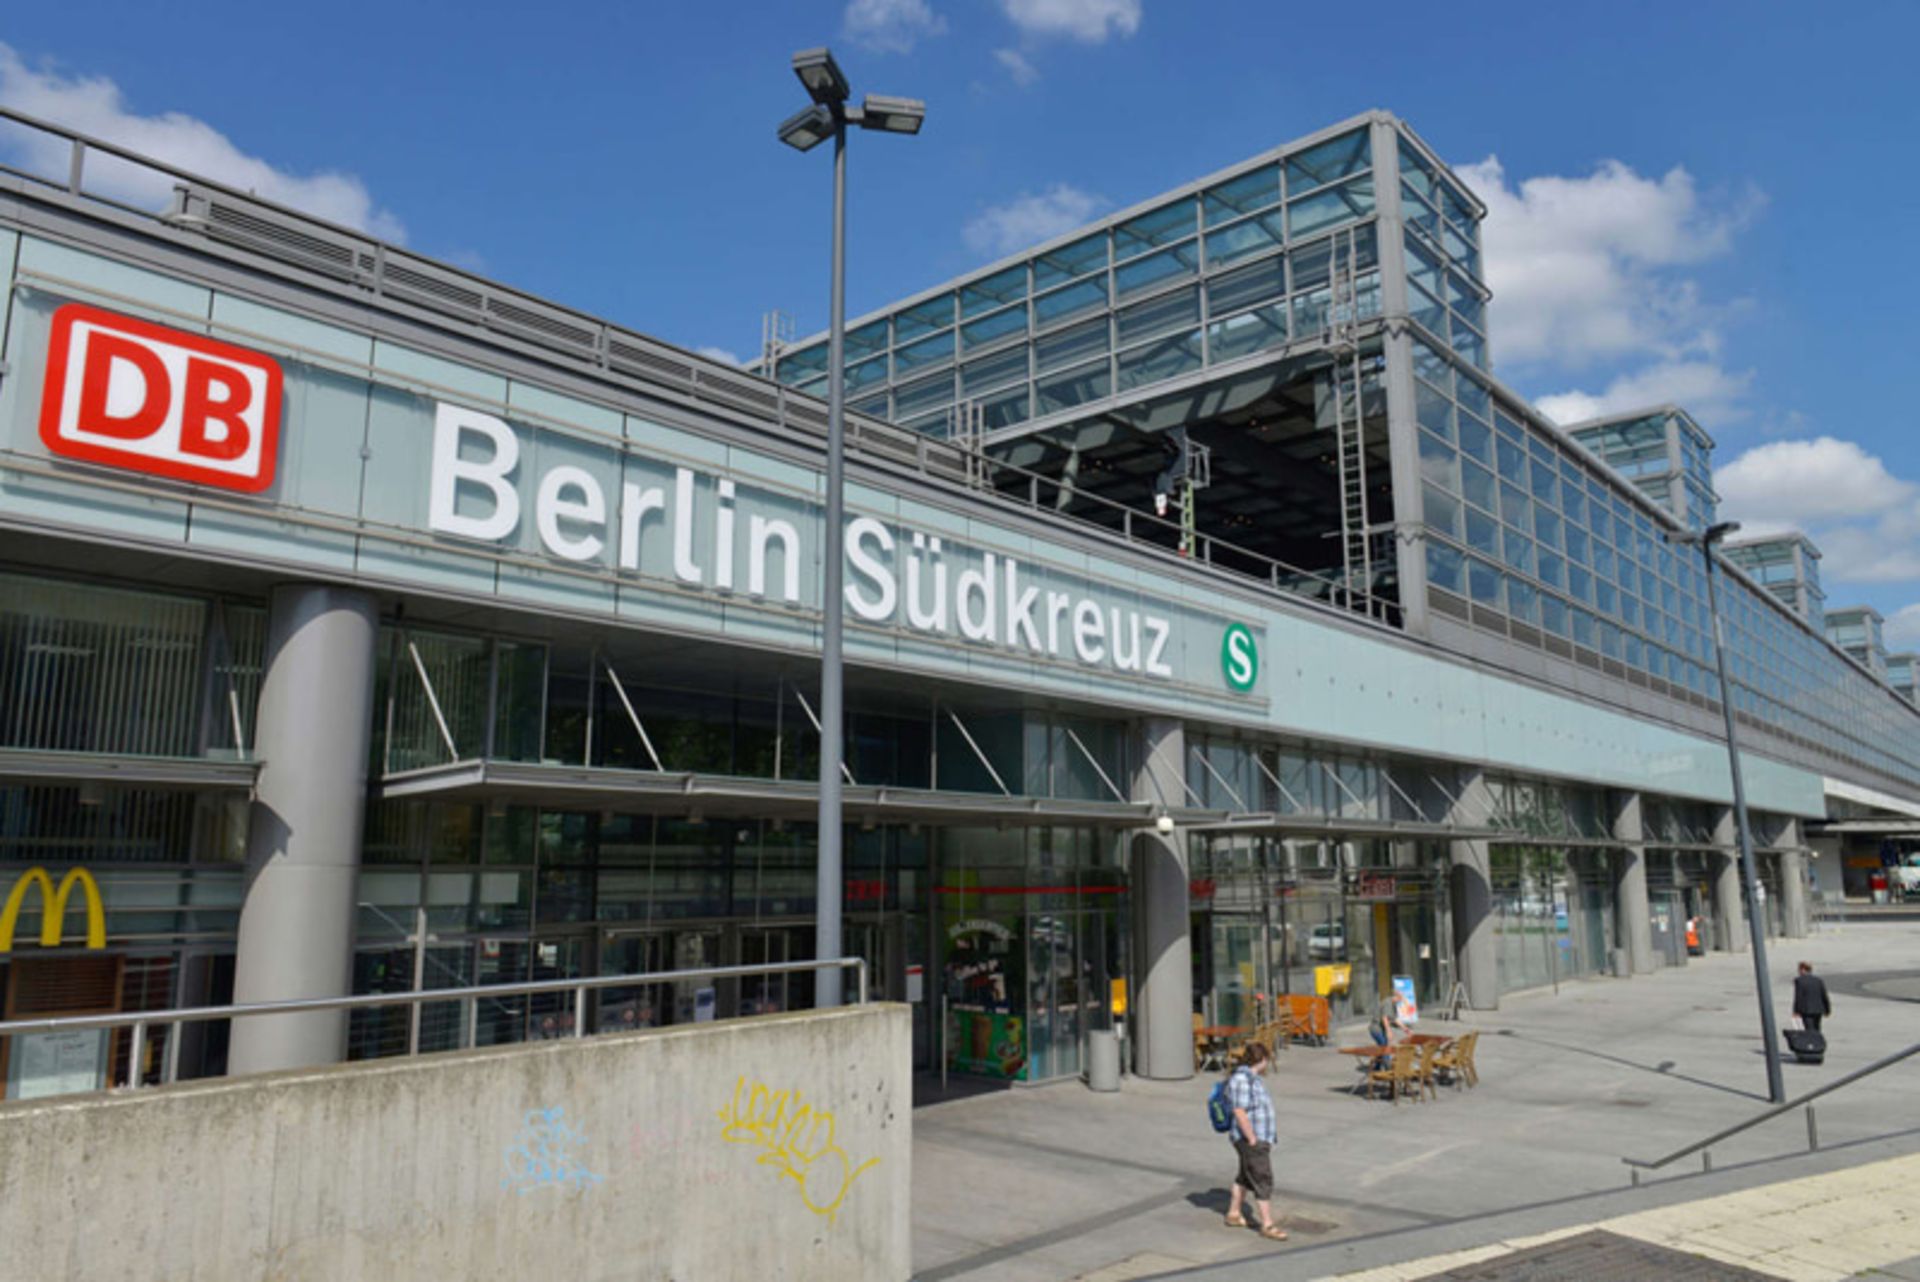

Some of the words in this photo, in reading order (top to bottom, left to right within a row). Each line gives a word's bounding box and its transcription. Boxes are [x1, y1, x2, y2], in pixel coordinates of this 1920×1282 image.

[76, 329, 254, 462] DB
[429, 401, 800, 602] Berlin
[843, 517, 1172, 677] Südkreuz
[1228, 630, 1253, 684] S
